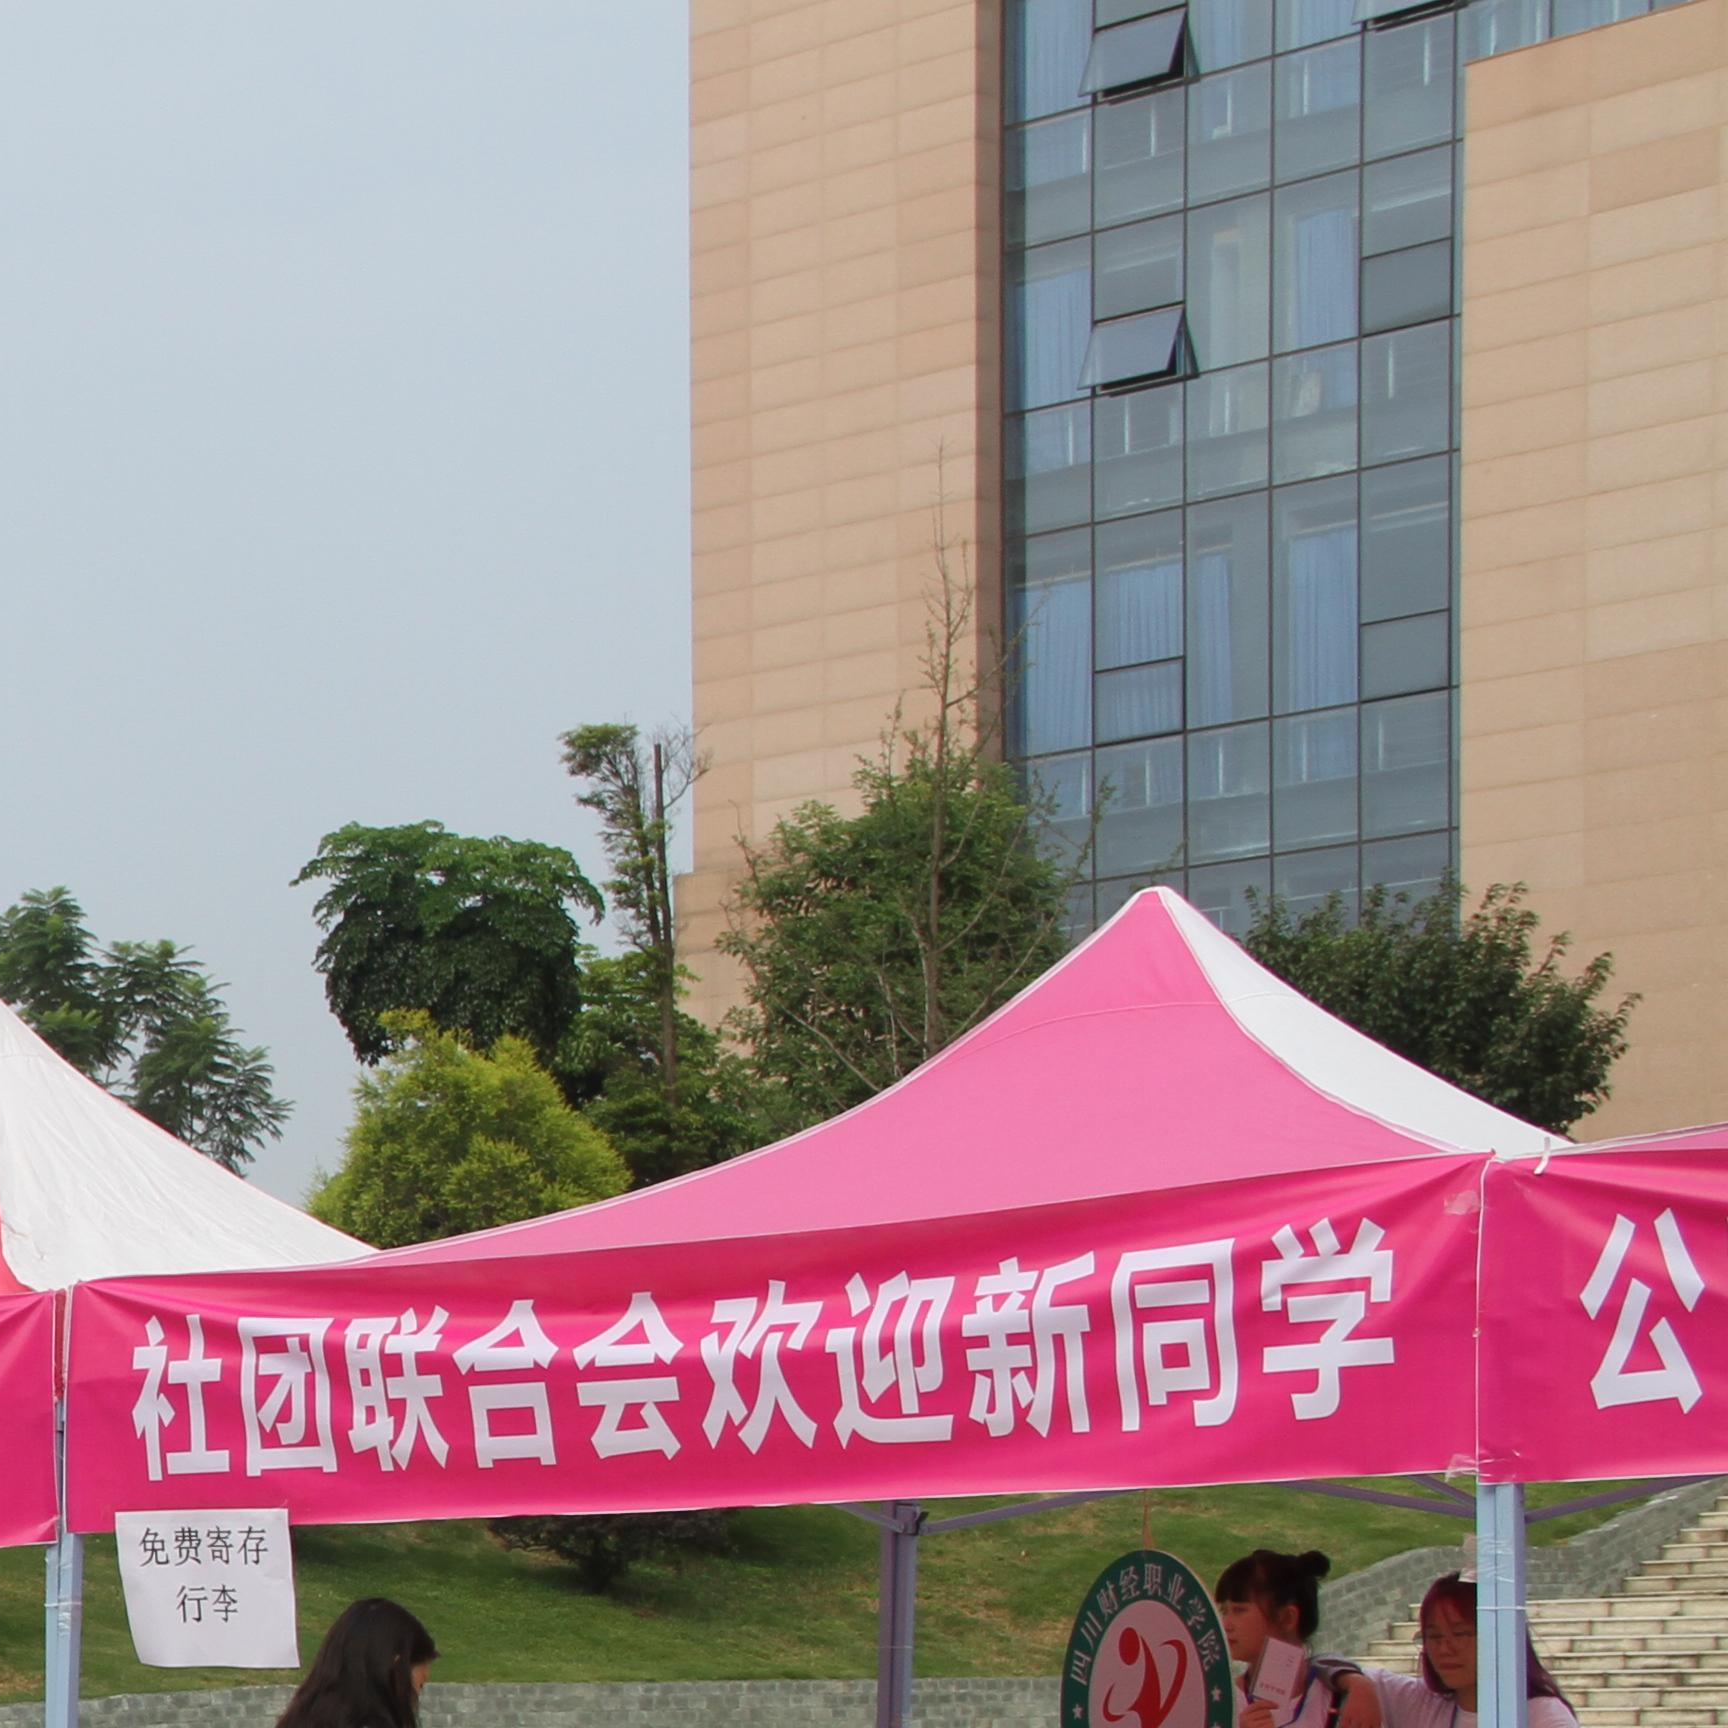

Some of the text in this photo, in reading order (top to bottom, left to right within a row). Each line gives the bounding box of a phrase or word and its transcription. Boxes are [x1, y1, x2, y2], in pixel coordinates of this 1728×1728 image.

[132, 1218, 1394, 1485] 社团联合会欢迎新同学
[139, 1525, 269, 1567] 免费寄存
[176, 1584, 259, 1623] 行李
[1070, 1562, 1222, 1687] 四川财经职业学院
